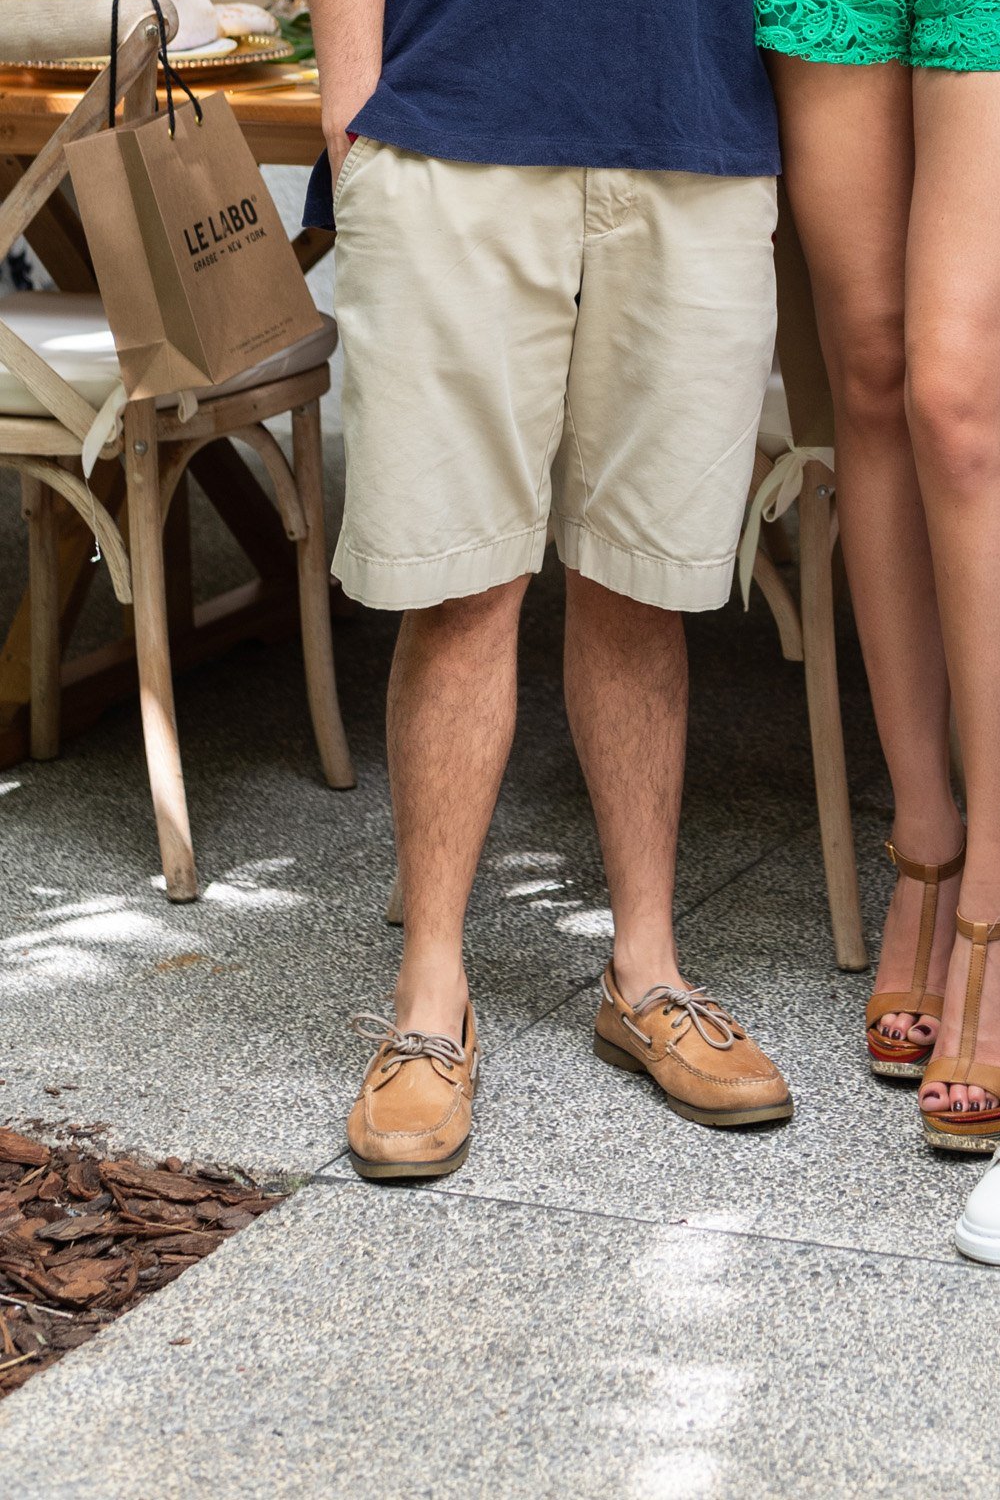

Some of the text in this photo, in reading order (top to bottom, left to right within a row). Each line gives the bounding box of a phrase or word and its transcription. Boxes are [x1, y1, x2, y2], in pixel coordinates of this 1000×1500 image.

[184, 221, 209, 256] LE
[193, 252, 218, 272] GRASSE
[227, 239, 242, 253] NEW
[245, 227, 267, 244] YORK
